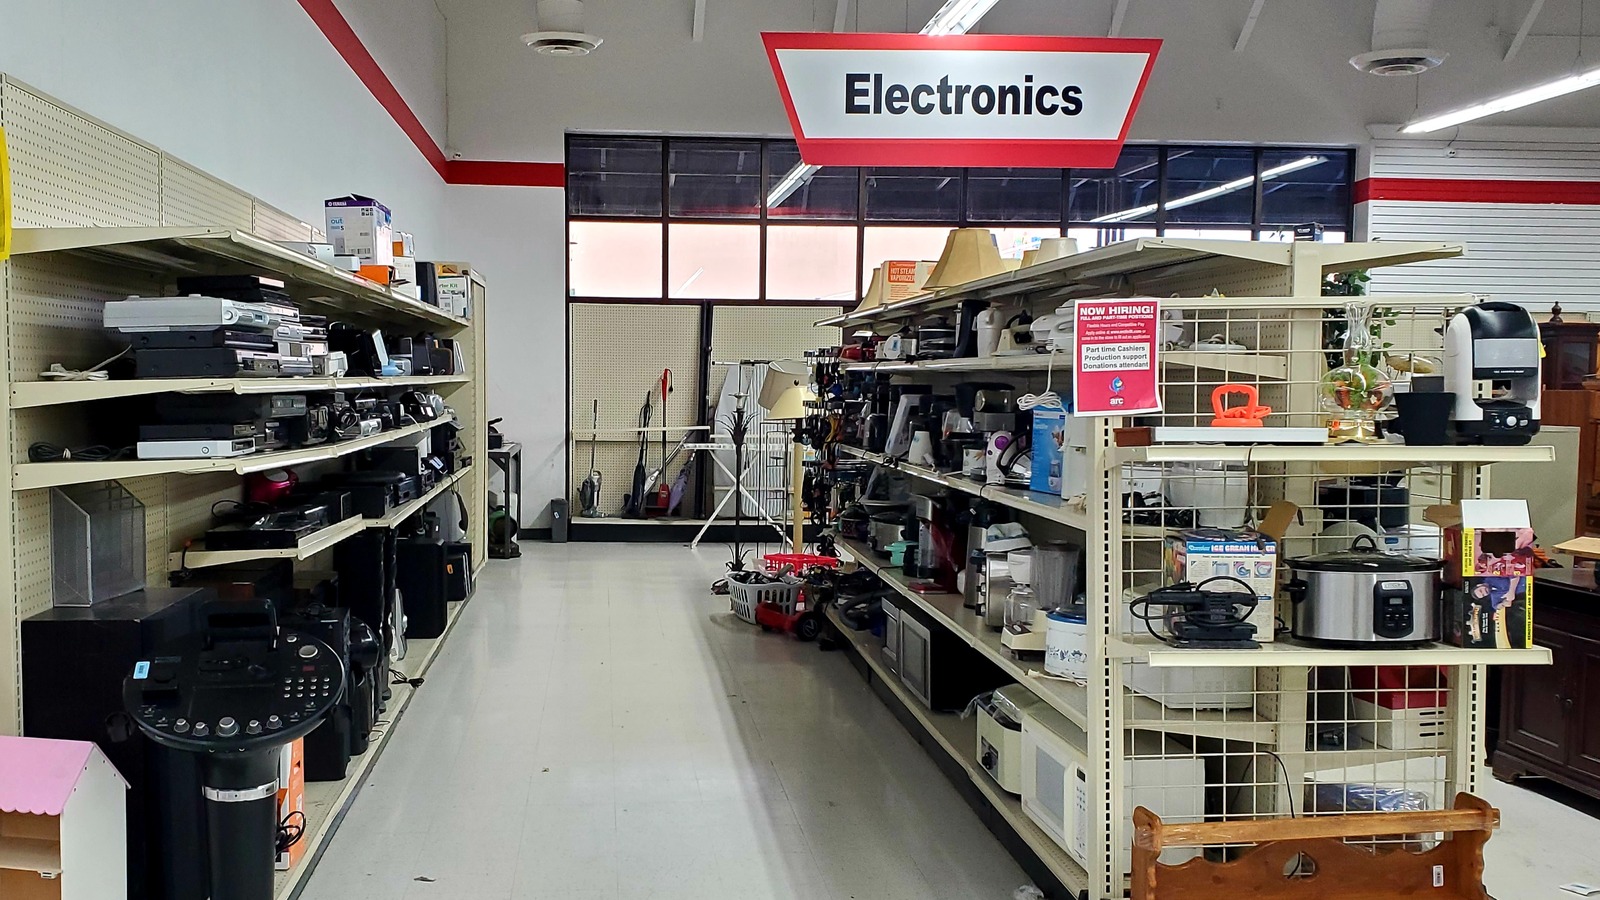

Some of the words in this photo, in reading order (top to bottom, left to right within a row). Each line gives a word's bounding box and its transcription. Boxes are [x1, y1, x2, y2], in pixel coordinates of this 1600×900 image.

[845, 73, 1083, 116] Electronics
[1080, 307, 1105, 315] NOW
[1109, 306, 1154, 314] HIRING!
